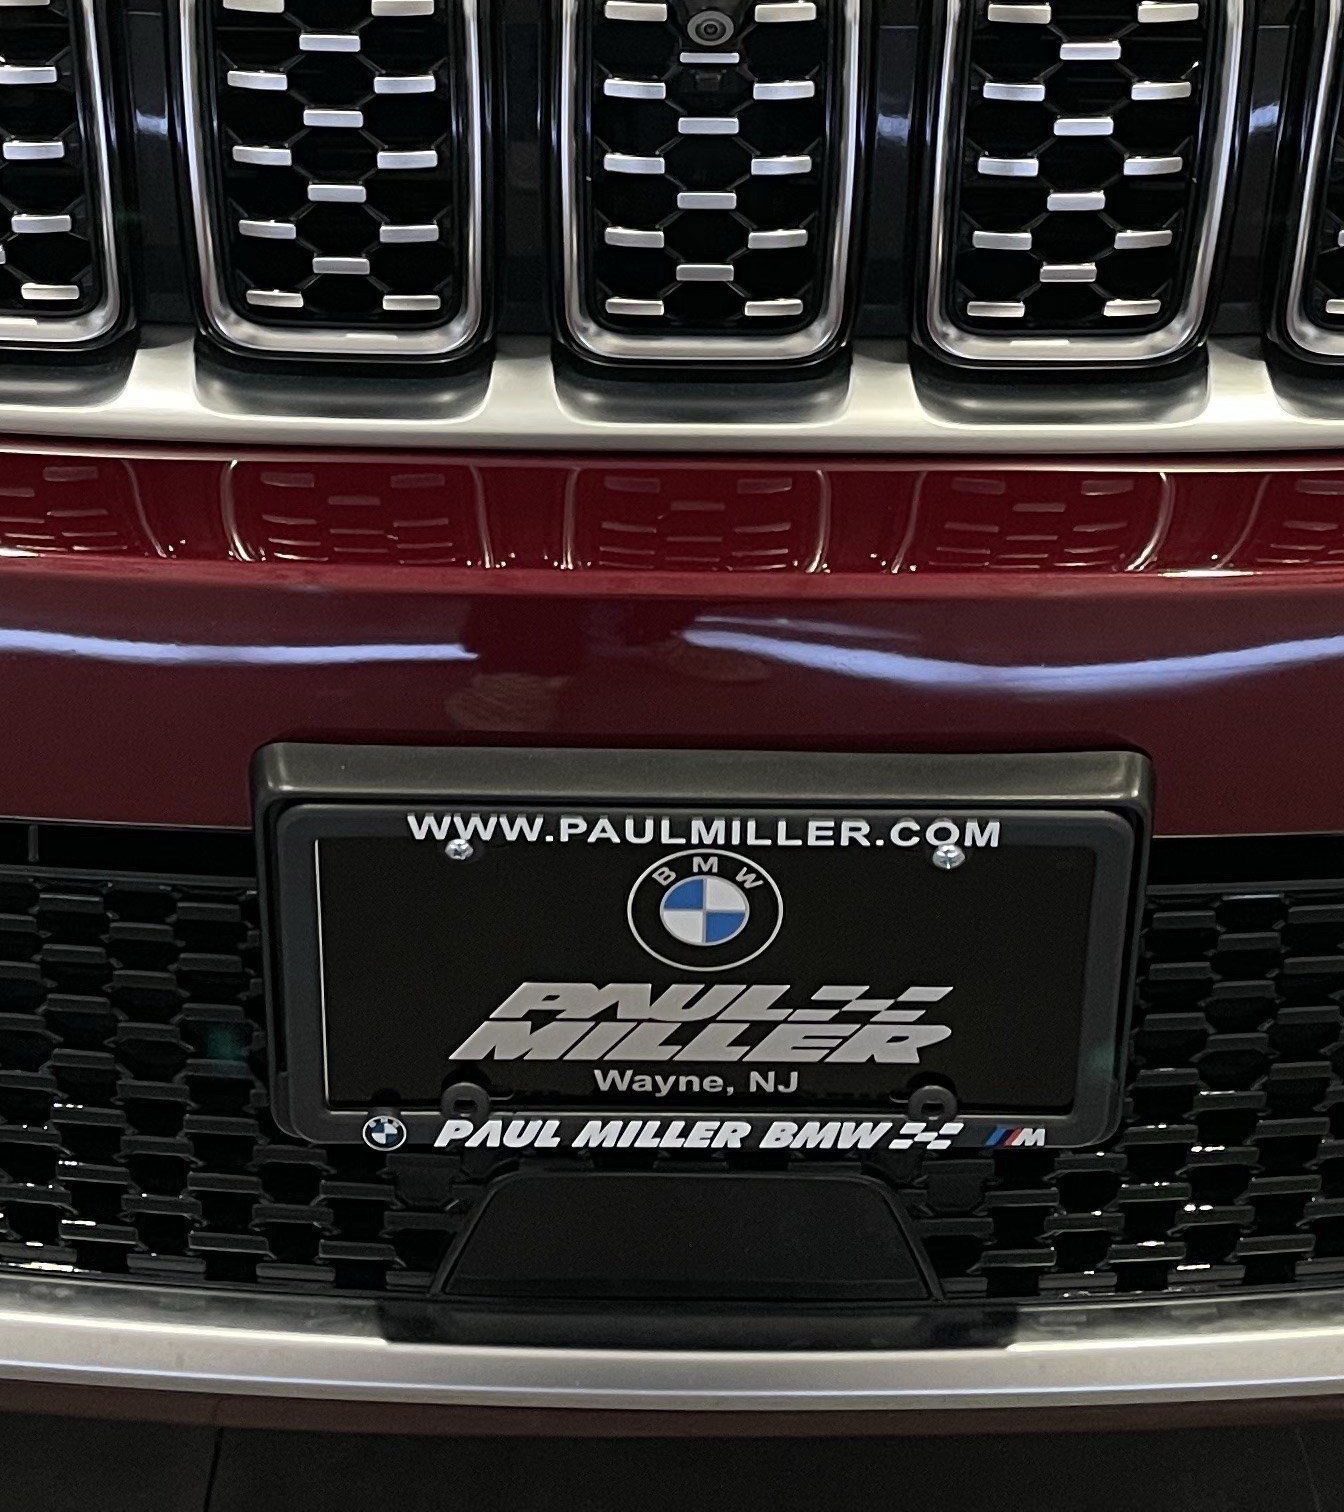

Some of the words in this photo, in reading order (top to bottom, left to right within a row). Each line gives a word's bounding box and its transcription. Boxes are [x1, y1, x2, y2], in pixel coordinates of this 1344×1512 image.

[407, 813, 1001, 849] WWW.PAULMILLER.COM
[651, 856, 765, 889] BMW
[489, 982, 794, 1022] PAUL
[449, 1021, 953, 1064] MILLER
[593, 1069, 735, 1096] Wayne,
[749, 1070, 800, 1094] NJ
[433, 1119, 562, 1148] PAUL
[571, 1120, 753, 1149] MILLER
[759, 1121, 894, 1150] BMW
